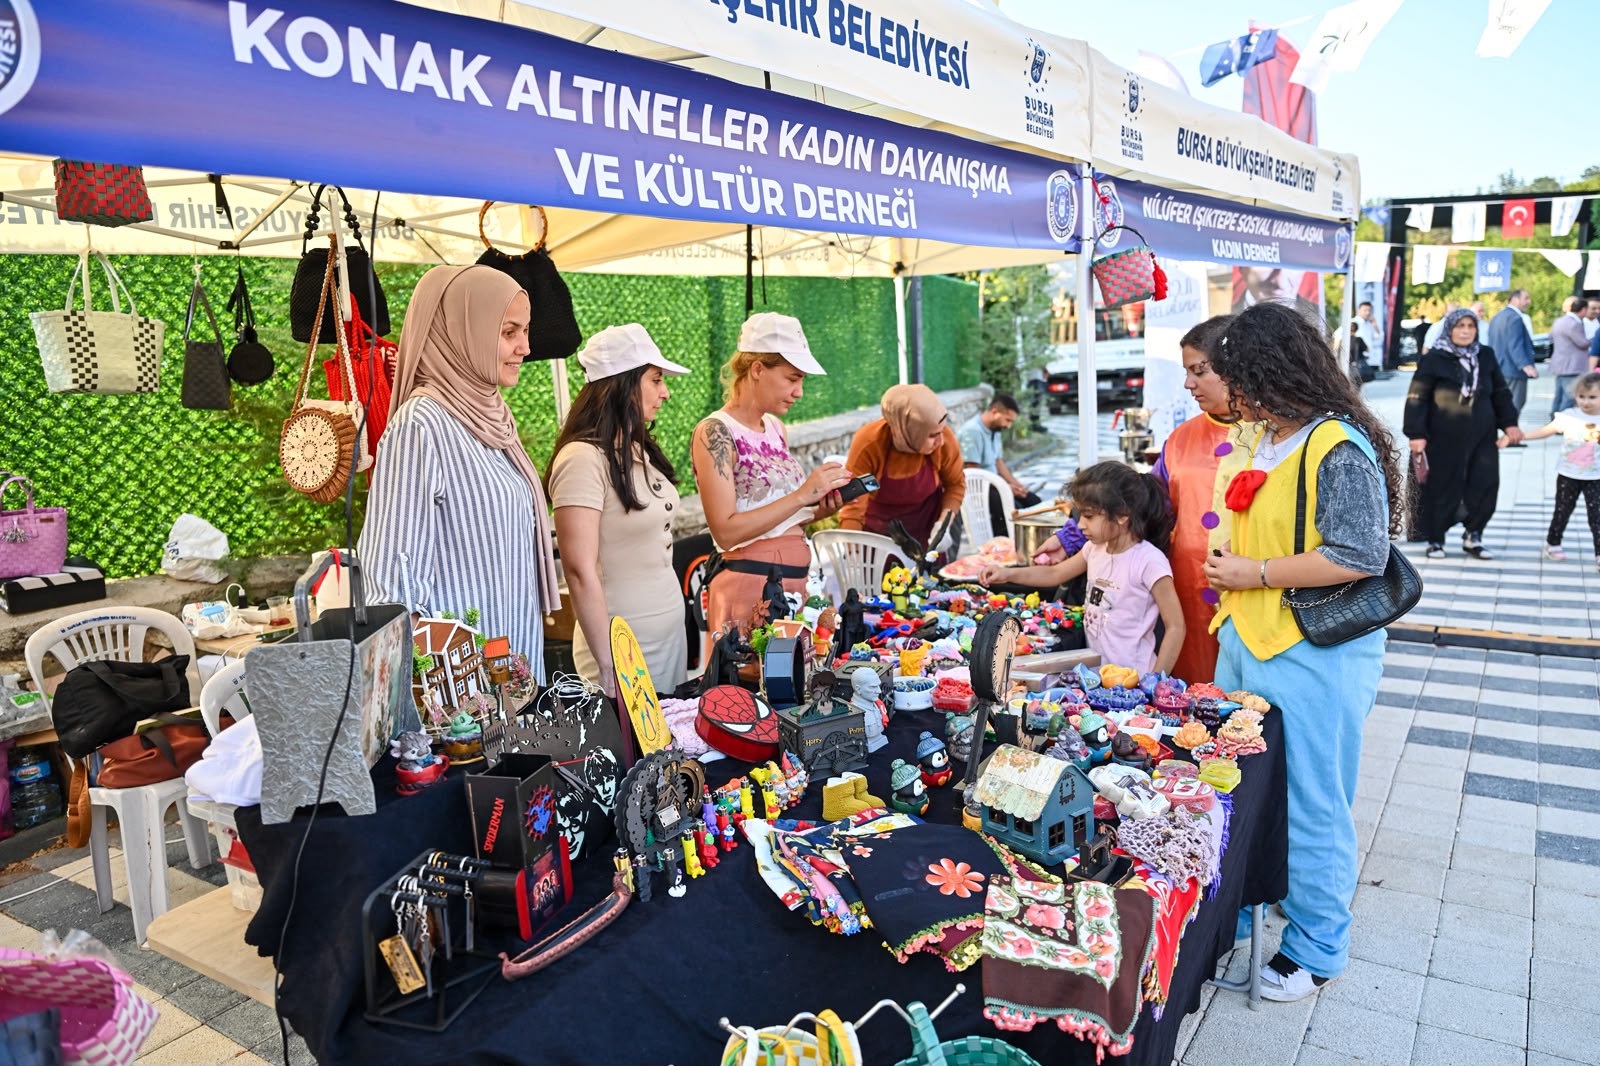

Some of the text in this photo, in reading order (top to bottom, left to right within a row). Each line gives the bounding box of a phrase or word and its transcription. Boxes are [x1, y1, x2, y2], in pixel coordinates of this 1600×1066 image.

[828, 0, 970, 90] BELEDİYESİ
[228, 0, 1012, 198] KONAK ALTINELLER KADIN DAYANIŞMA
[1024, 96, 1054, 117] BURSA
[1121, 125, 1142, 142] BURSA
[1177, 127, 1319, 193] BURSA BÜYÜKŞEHİR BELEDİYESİ
[554, 147, 917, 229] VE KÜLTÜR DERNEĞİ
[1142, 191, 1192, 225] NİLÜFER
[1193, 206, 1239, 232] IŞIKTEPE
[1237, 214, 1272, 237] SOSYAL
[1211, 238, 1281, 264] KADIN DERNEĞİ
[483, 797, 505, 854] SPIDERMAN
